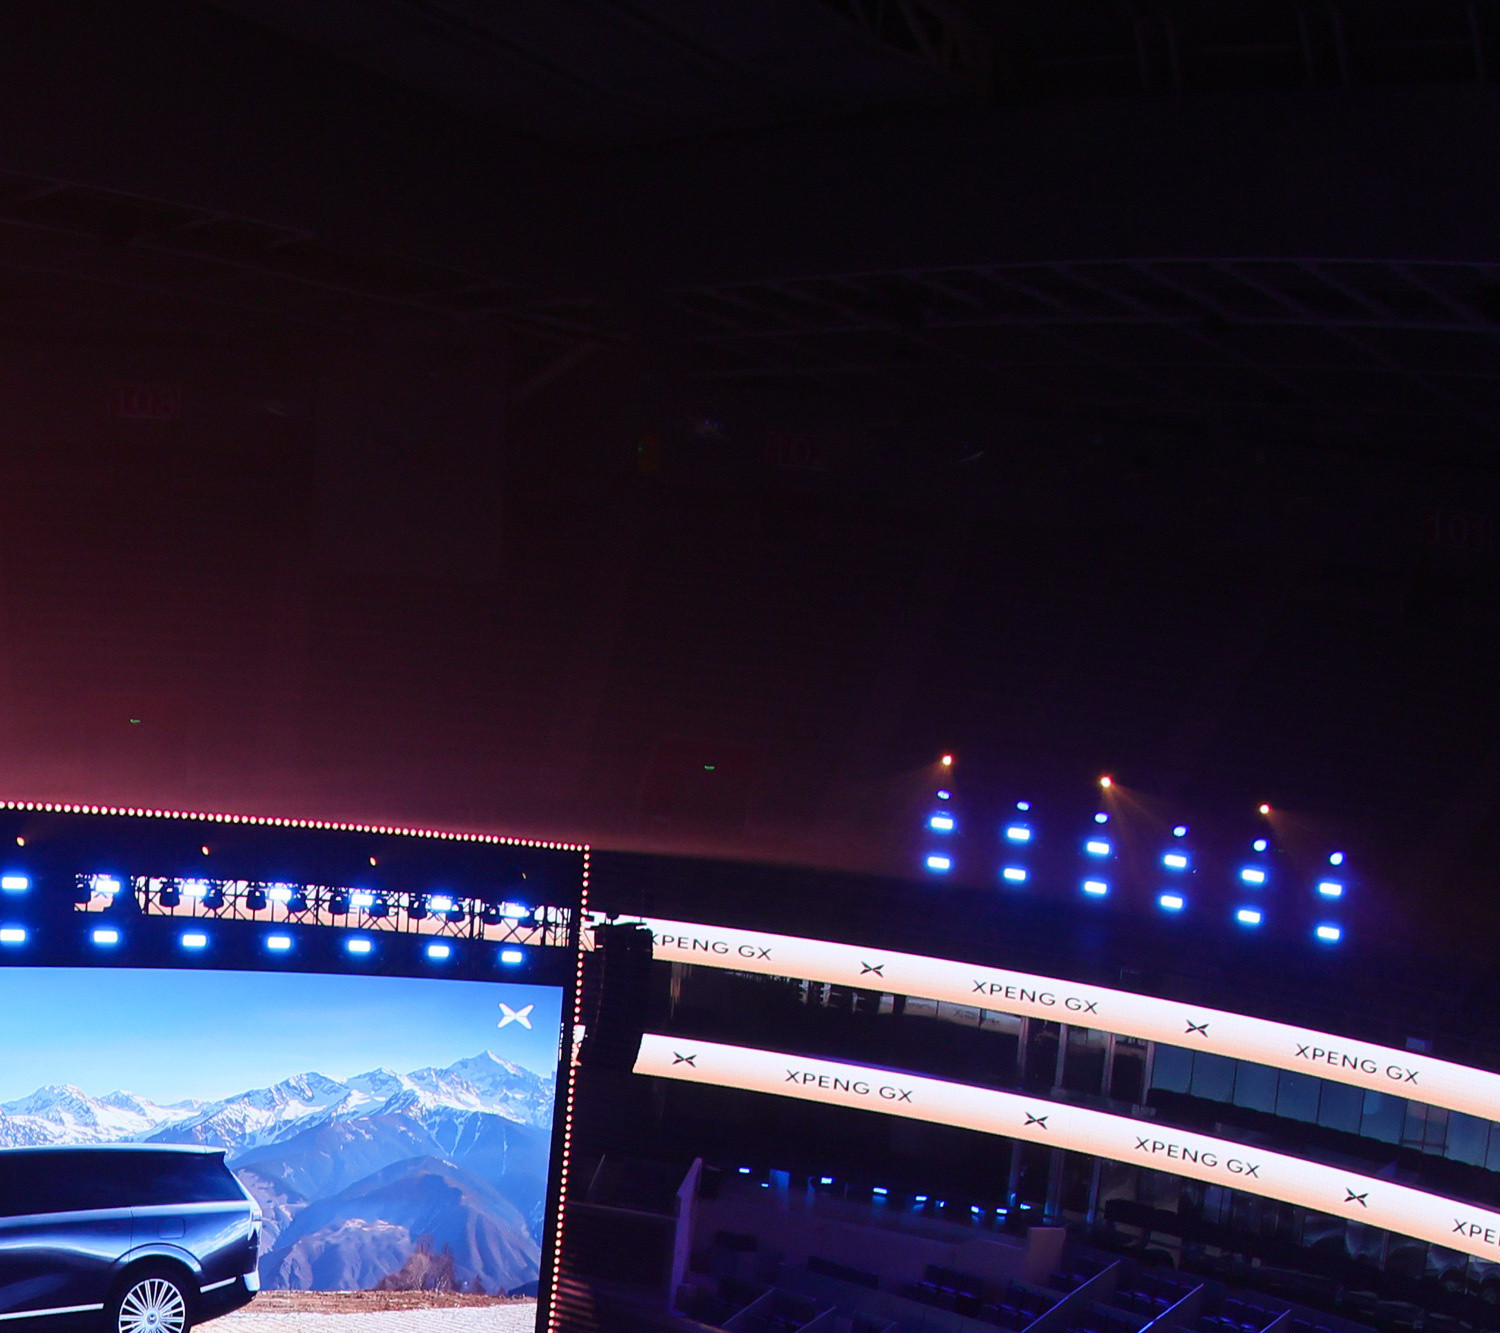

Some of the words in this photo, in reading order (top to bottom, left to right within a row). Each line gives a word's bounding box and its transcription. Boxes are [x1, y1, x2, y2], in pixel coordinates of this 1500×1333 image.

[737, 945, 772, 961] GX
[971, 980, 1056, 1007] XPENG
[1064, 997, 1098, 1015] GX
[1294, 1043, 1377, 1074] XPENG
[1385, 1065, 1419, 1085] GX
[784, 1069, 870, 1095] XPENG
[878, 1086, 913, 1104] GX
[1134, 1136, 1218, 1168] XPENG
[1226, 1159, 1260, 1179] GX
